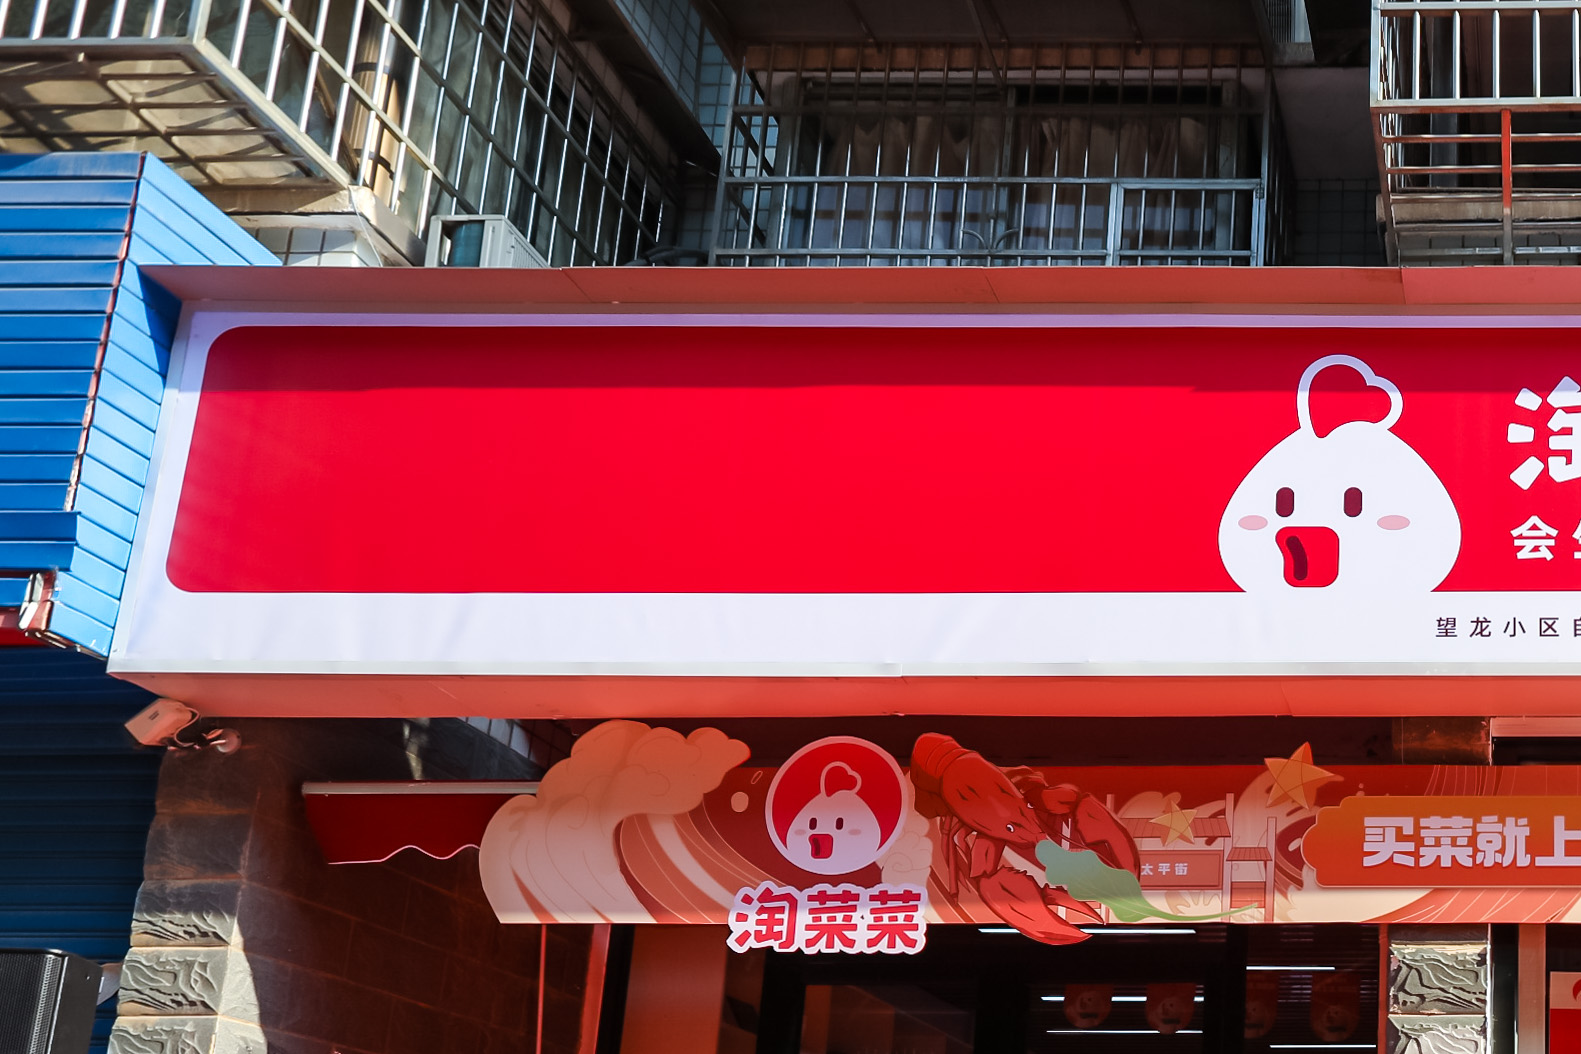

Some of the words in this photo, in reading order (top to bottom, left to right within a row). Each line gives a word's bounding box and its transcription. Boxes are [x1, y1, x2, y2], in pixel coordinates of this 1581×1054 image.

[1140, 863, 1189, 878] 太平街
[736, 889, 922, 951] 淘菜菜
